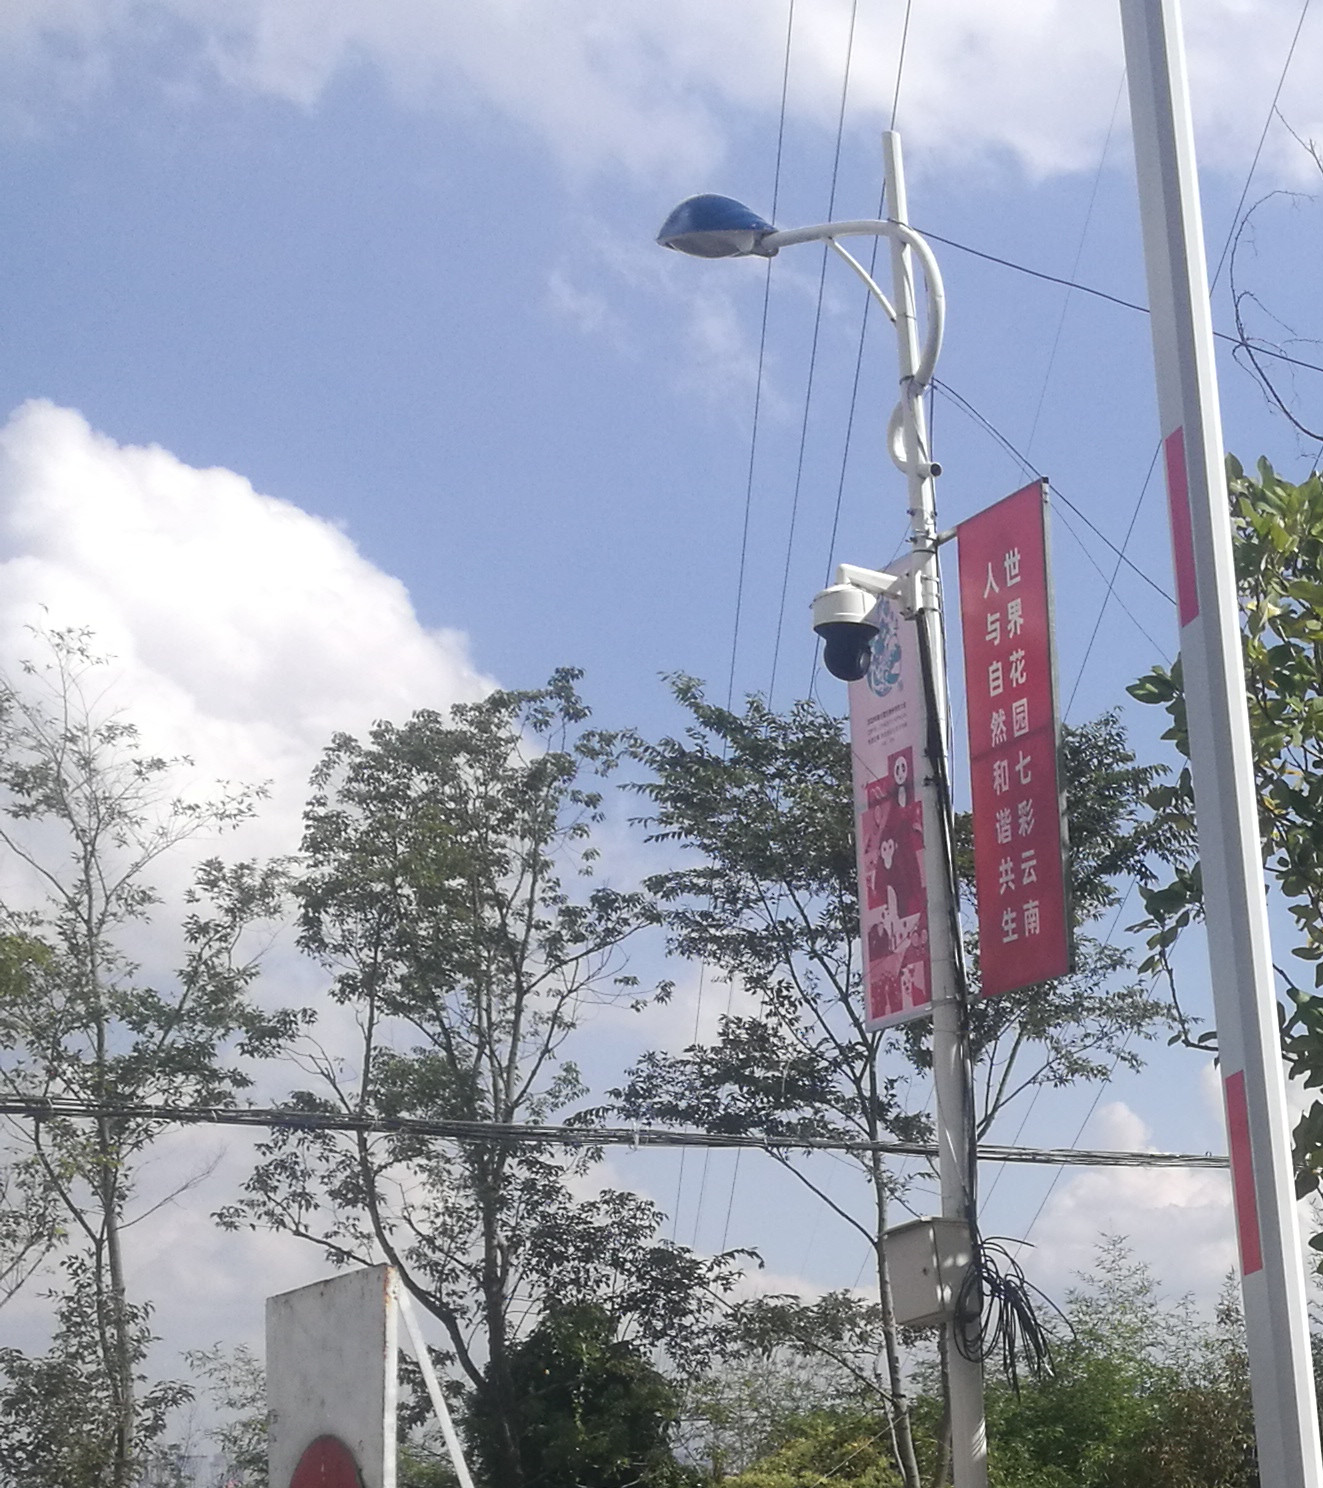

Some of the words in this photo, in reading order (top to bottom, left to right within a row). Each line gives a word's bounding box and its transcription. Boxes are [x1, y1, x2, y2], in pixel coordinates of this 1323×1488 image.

[983, 561, 1019, 944] 人与自然和谐共生
[1003, 546, 1041, 938] 世界花园七彩云南
